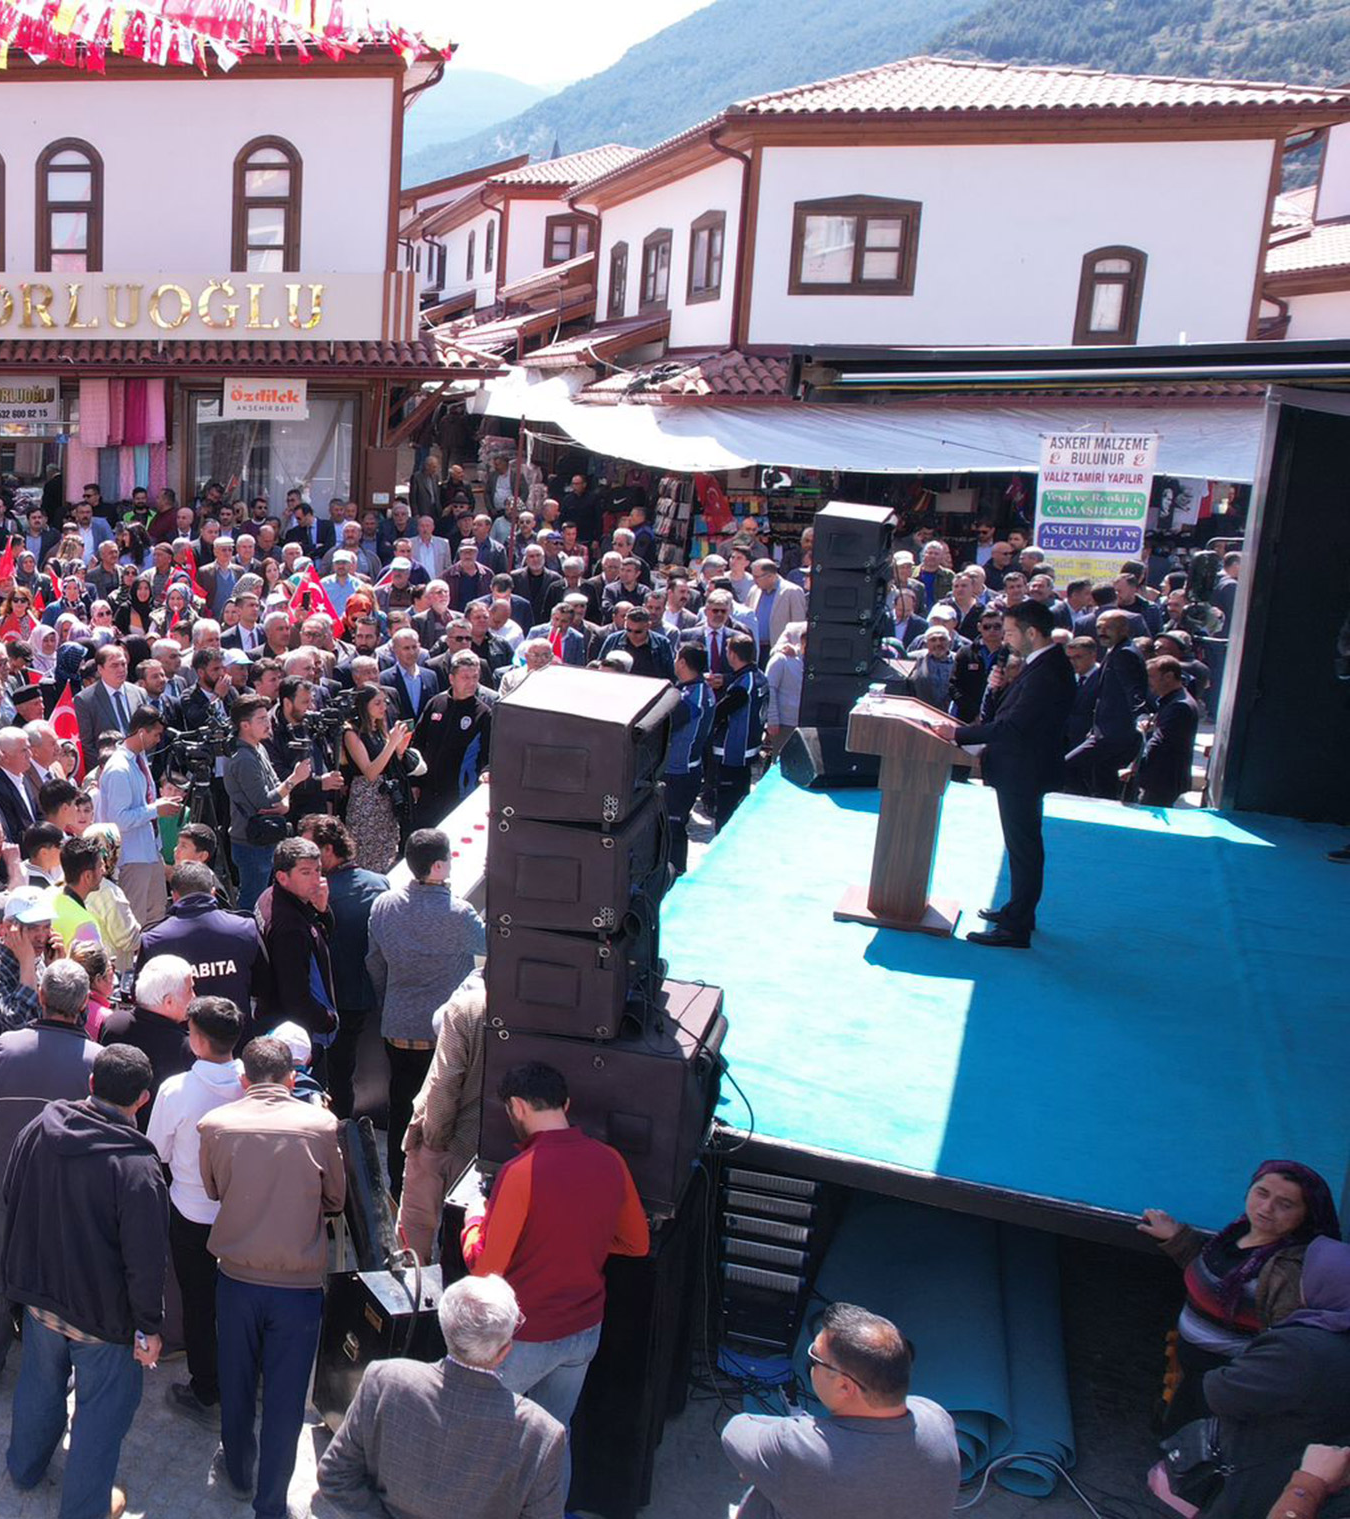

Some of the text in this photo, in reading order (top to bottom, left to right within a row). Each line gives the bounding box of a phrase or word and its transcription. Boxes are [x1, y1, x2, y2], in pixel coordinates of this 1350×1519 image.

[1093, 437, 1149, 451] MALZEME
[1071, 452, 1125, 465] BULUNUR
[1042, 538, 1136, 552] EL ÇANTALARI
[190, 960, 237, 979] ABITA
